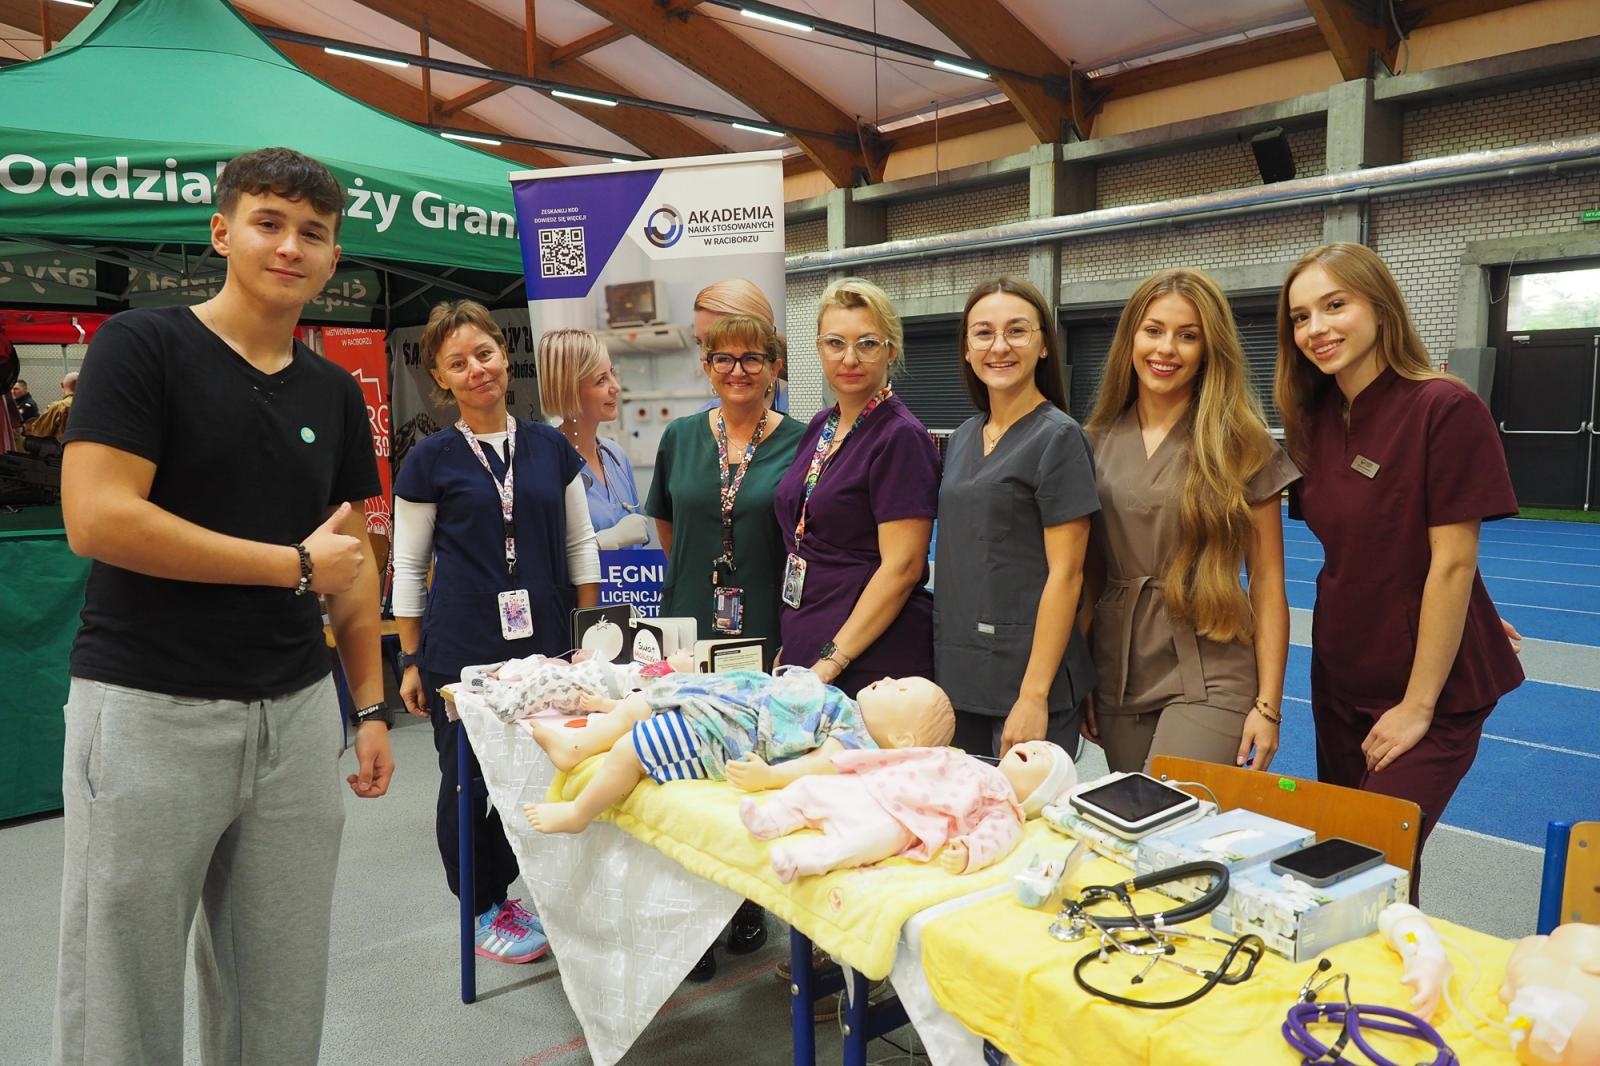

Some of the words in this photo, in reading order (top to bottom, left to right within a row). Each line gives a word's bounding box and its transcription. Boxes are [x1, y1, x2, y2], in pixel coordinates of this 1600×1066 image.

[343, 178, 400, 233] ży
[411, 190, 520, 240] Gran
[688, 206, 773, 224] AKADEMIA
[712, 221, 774, 232] STOSOWANYCH
[713, 235, 759, 245] RACIBORZU
